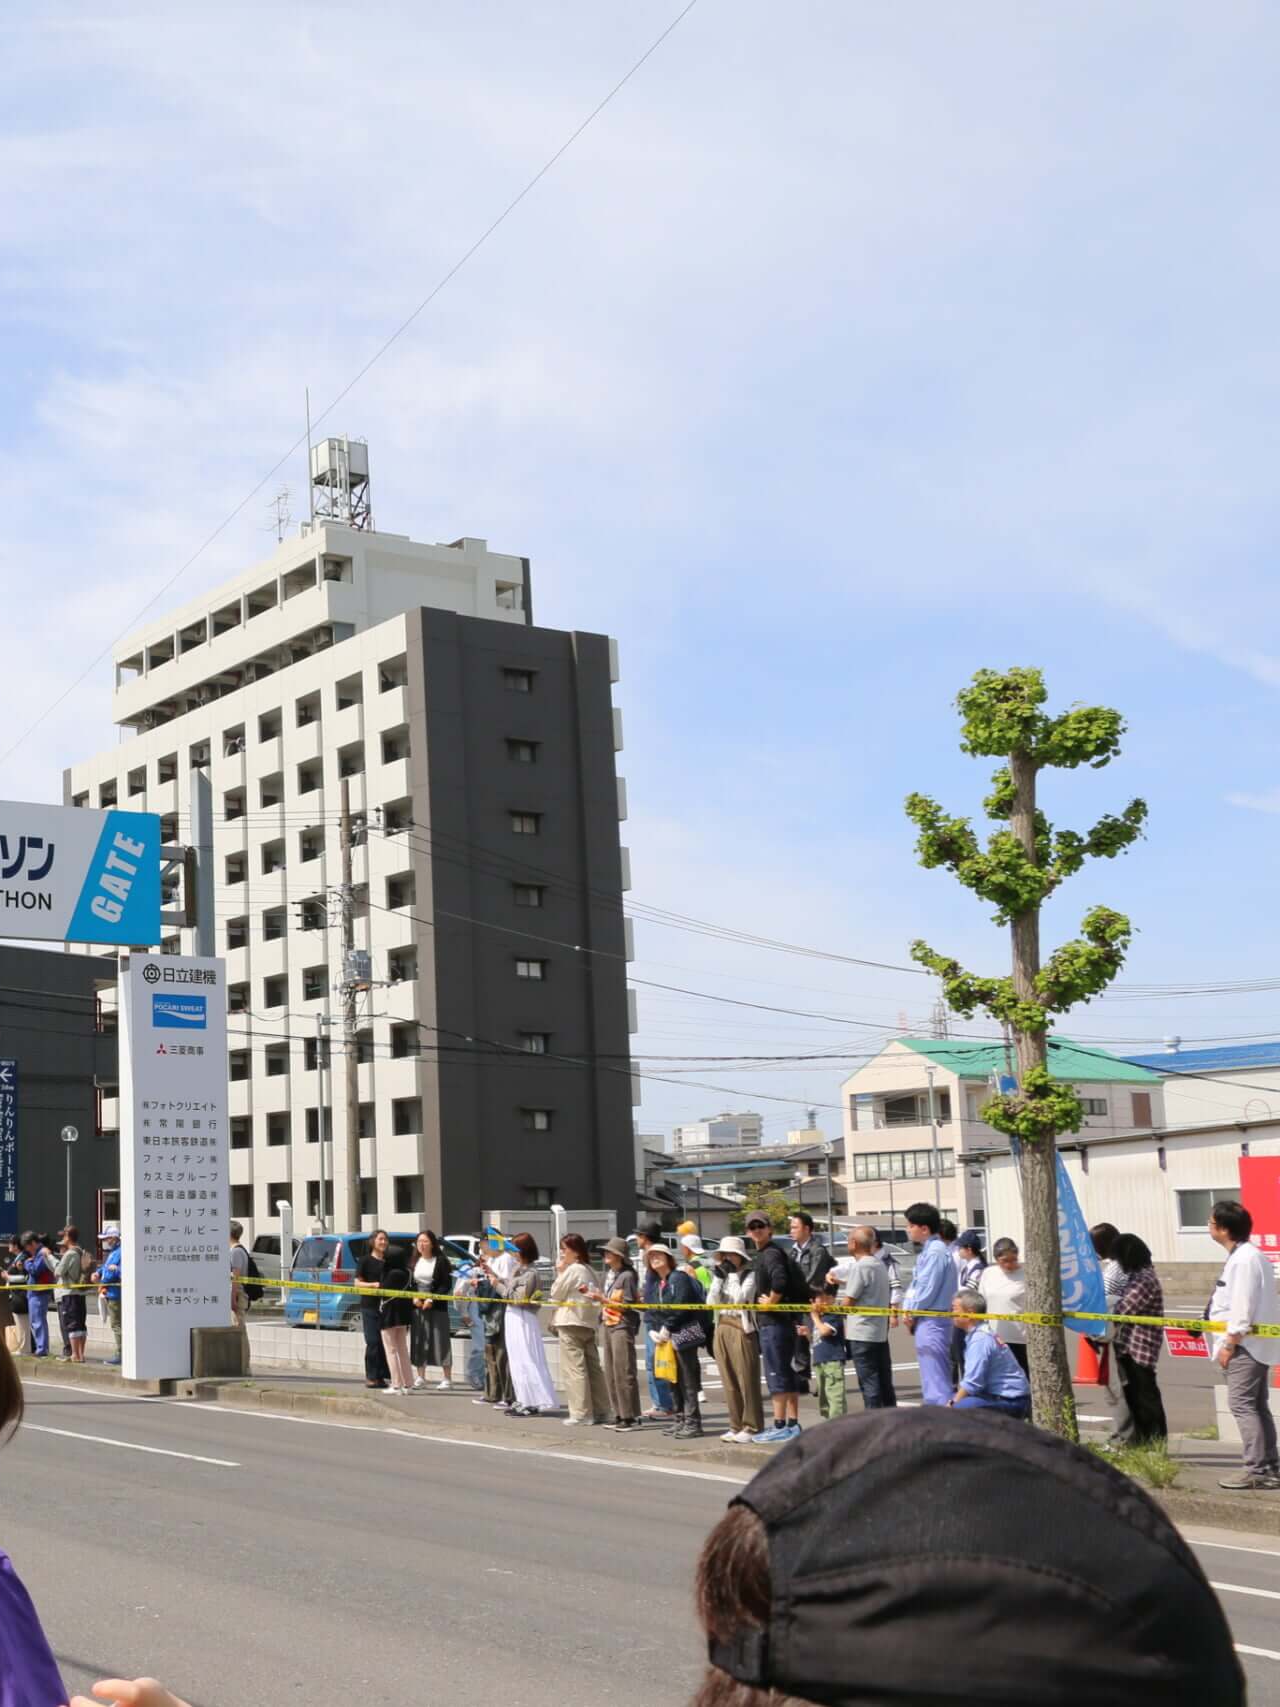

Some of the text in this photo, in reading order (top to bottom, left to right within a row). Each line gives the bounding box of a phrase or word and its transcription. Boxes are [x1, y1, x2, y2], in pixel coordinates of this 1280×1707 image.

[90, 832, 145, 923] GATE
[163, 968, 217, 985] 日立建機
